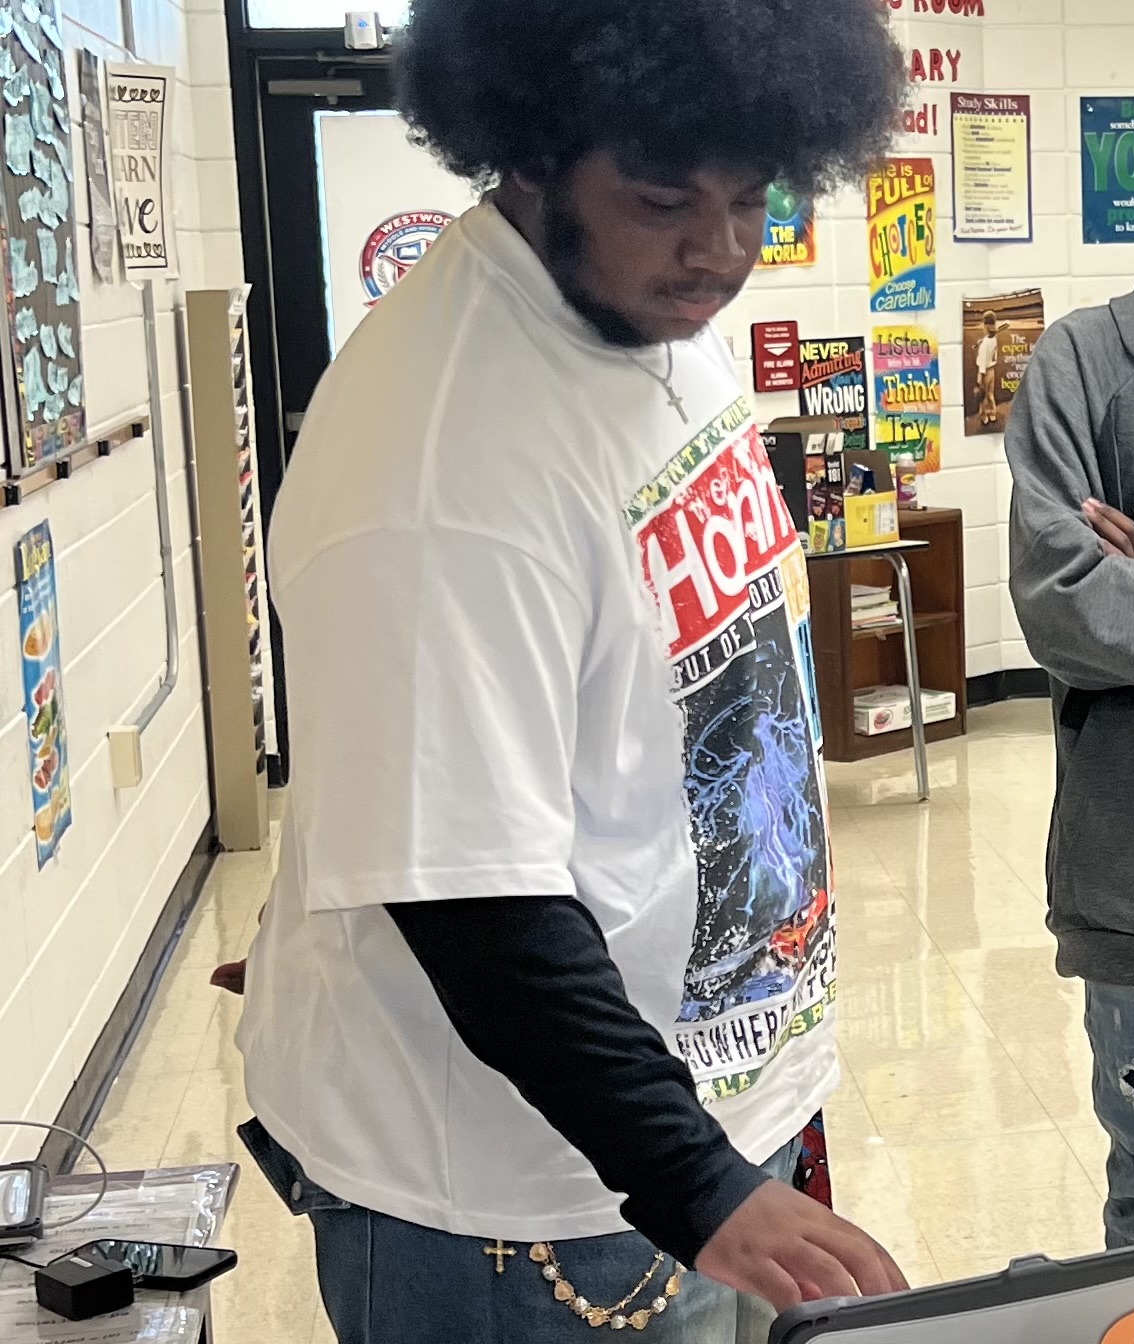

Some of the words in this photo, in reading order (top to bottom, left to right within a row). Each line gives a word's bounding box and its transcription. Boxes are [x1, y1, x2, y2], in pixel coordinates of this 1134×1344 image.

[957, 96, 982, 113] Study
[983, 97, 1018, 111] Skills
[900, 163, 913, 177] is
[868, 174, 930, 217] FULL
[770, 225, 795, 244] THE
[1115, 223, 1124, 232] to
[869, 203, 936, 279] CHOICES
[761, 243, 808, 264] WORLD
[885, 279, 917, 295] Choose
[877, 331, 931, 358] Listen
[1002, 343, 1027, 355] expert
[1010, 334, 1026, 344] The
[800, 341, 849, 364] NEVER
[801, 350, 863, 382] Admitting
[805, 383, 865, 417] WRONG
[882, 374, 938, 405] Think
[885, 413, 928, 451] Try
[719, 622, 742, 660] OF
